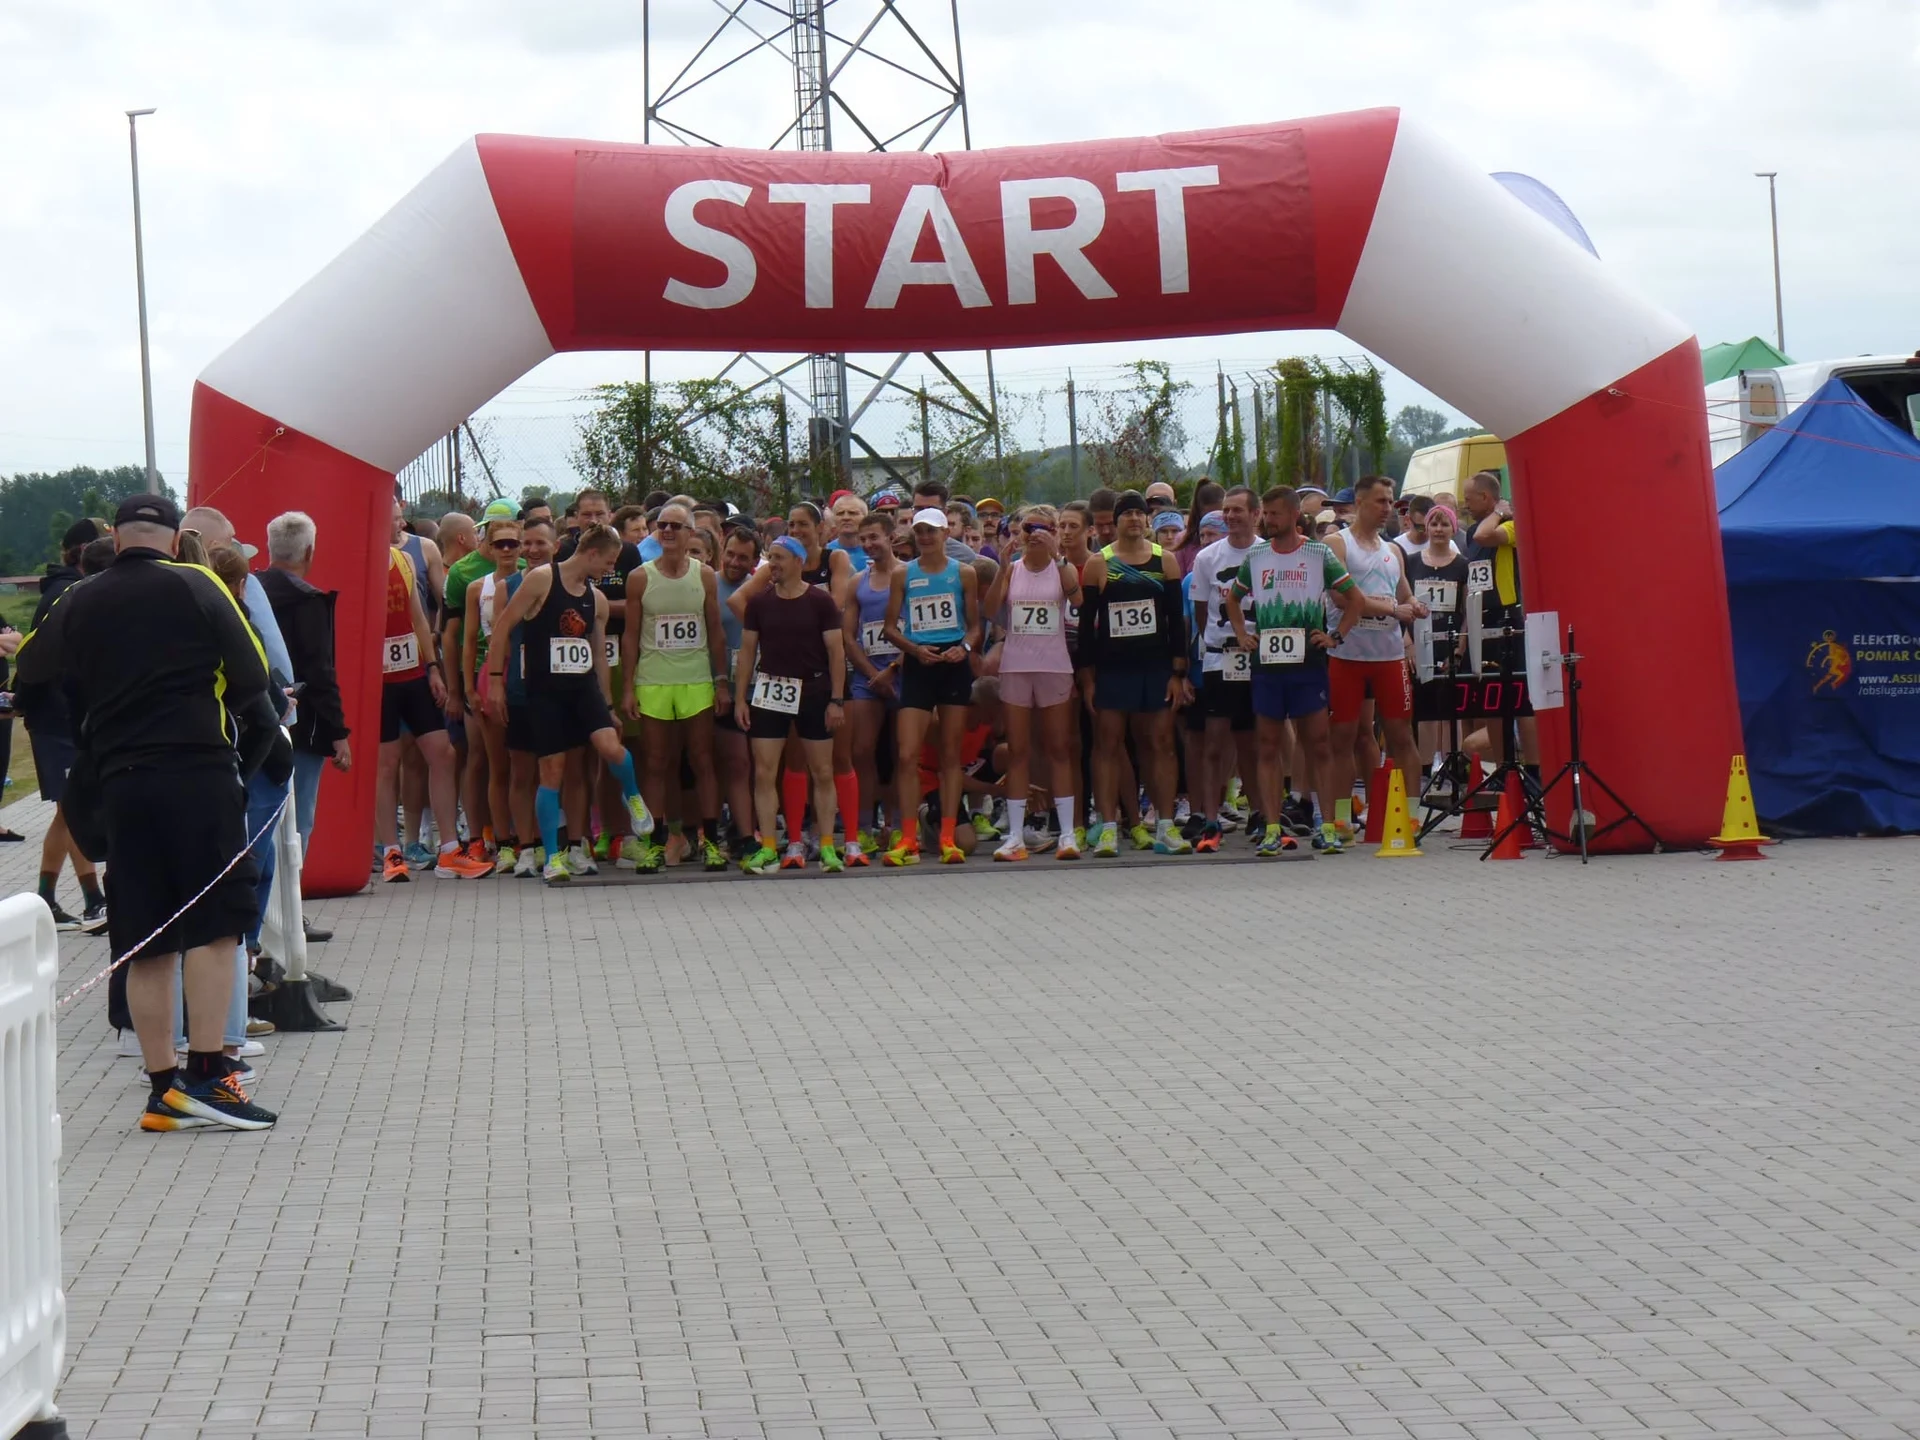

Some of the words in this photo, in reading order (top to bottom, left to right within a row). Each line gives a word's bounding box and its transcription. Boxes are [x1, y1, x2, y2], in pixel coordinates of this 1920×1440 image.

[662, 165, 1220, 310] START
[1275, 569, 1308, 582] JURUND
[1471, 566, 1489, 584] 43
[914, 600, 952, 621] 118
[1022, 607, 1048, 625] 78
[1114, 606, 1152, 627] 136
[660, 620, 697, 640] 168
[389, 642, 411, 662] 81
[1269, 635, 1294, 654] 80
[556, 645, 589, 664] 109
[1234, 653, 1252, 671] 3
[1856, 650, 1910, 661] POMIAR
[1858, 674, 1920, 684] www.ASSI
[761, 681, 798, 703] 133
